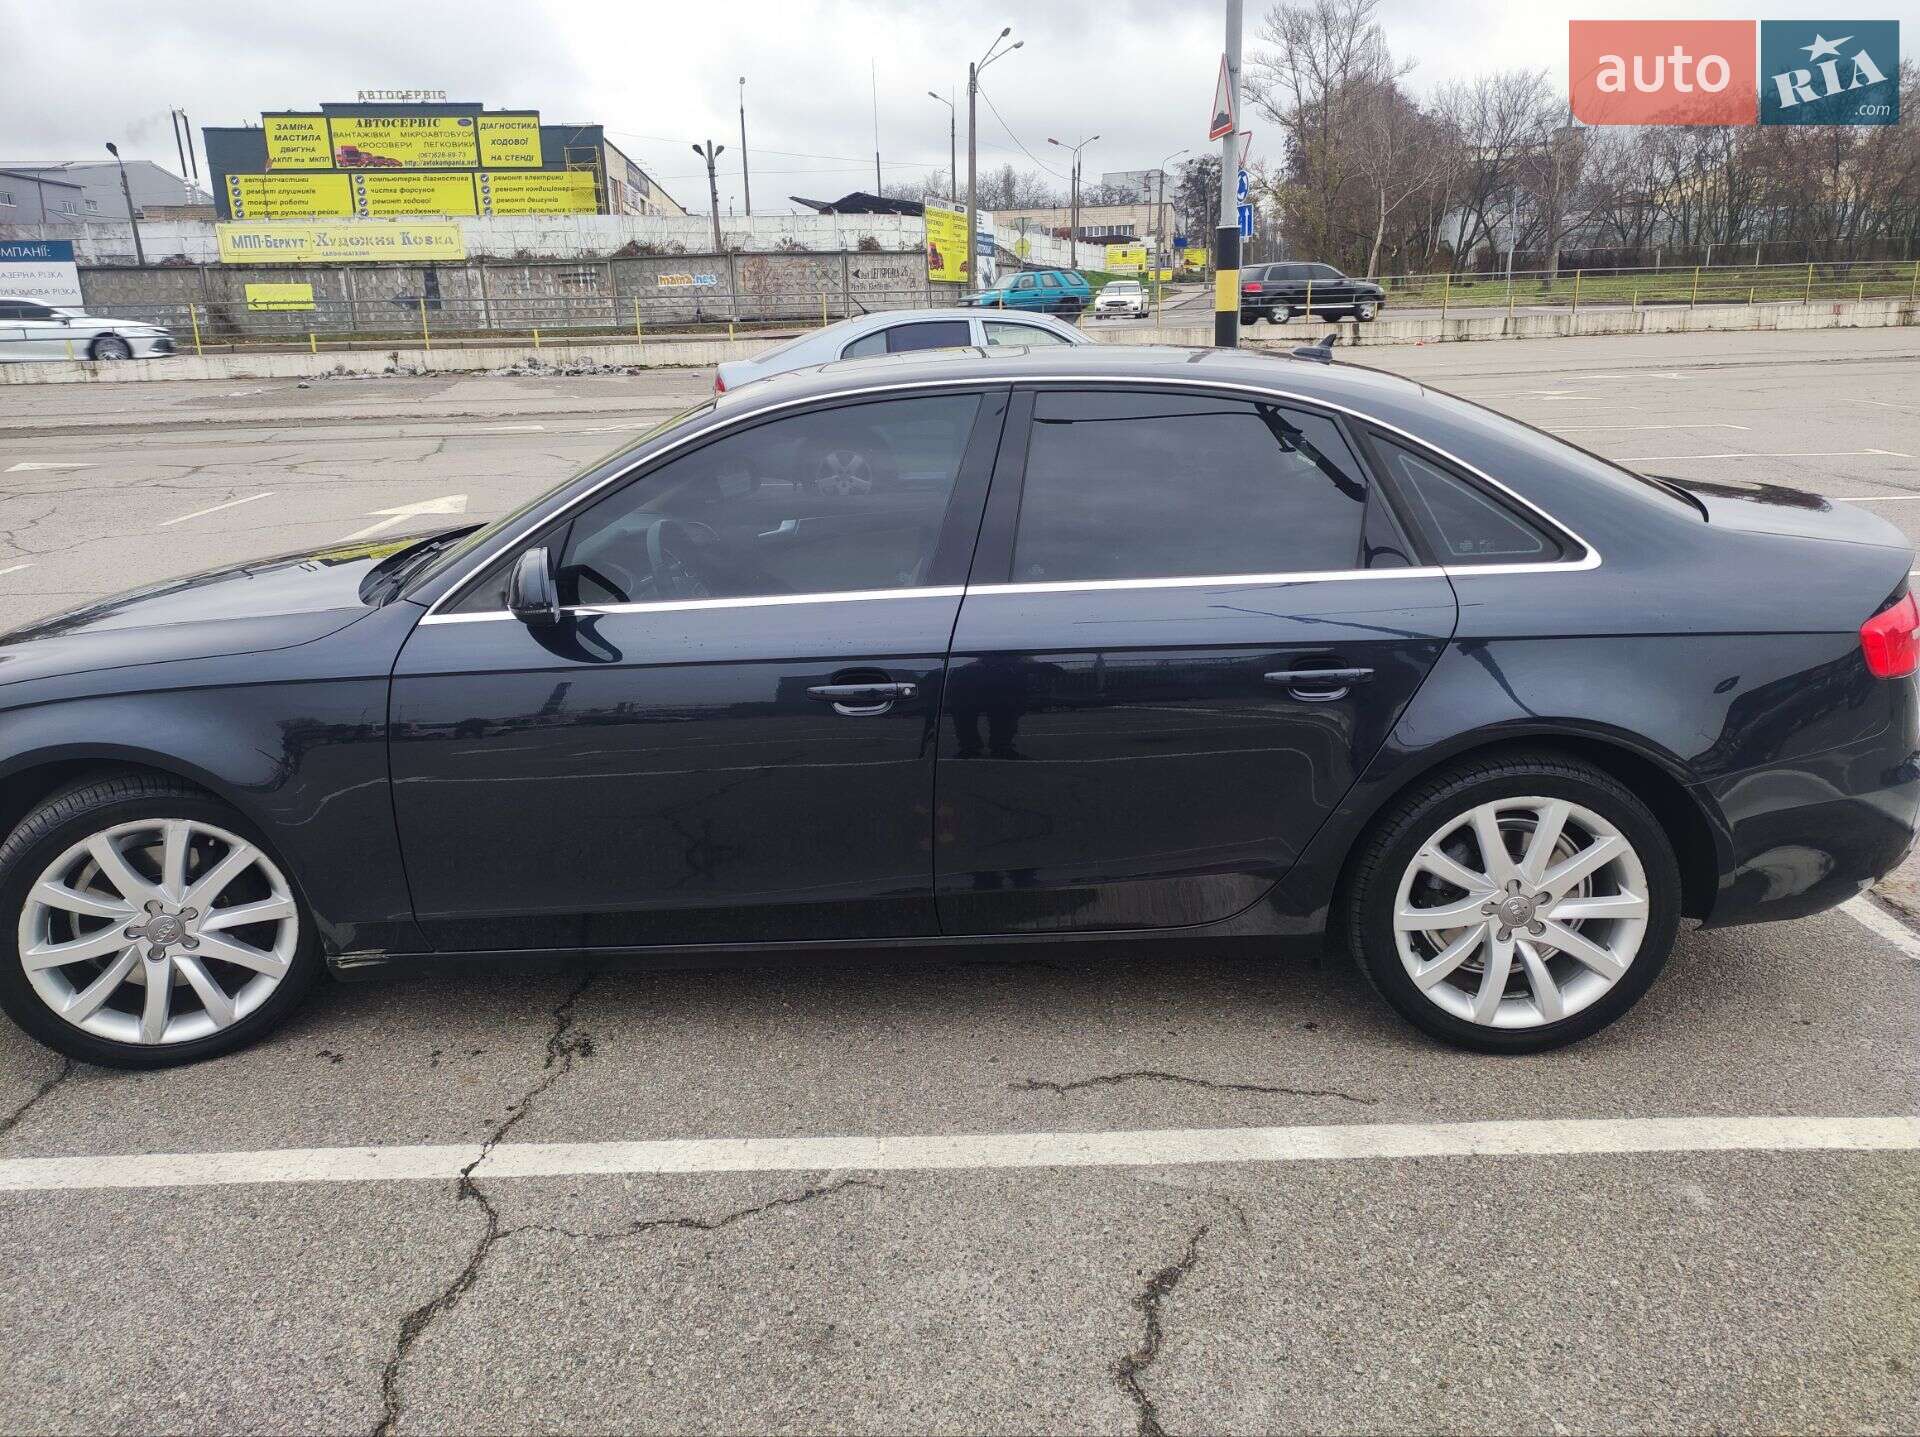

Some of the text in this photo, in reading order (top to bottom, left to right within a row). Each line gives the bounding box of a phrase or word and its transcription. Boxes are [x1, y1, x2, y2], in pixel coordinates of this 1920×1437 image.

[357, 91, 446, 100] АВТОСЕРВІС
[275, 123, 314, 131] ЗАМІНА
[355, 118, 441, 128] АВТОСЕРВІС
[480, 122, 537, 131] ДІАГНОСТИКА
[273, 134, 322, 142] МАСТИЛА
[399, 130, 475, 138] МІКРОАВТОБУСИ
[357, 141, 413, 149] КРОСОВЕРИ
[490, 137, 529, 146] ХОДОВОЇ
[280, 146, 316, 154] ДВИГУНА
[490, 154, 534, 162] НА СТЕНДІ
